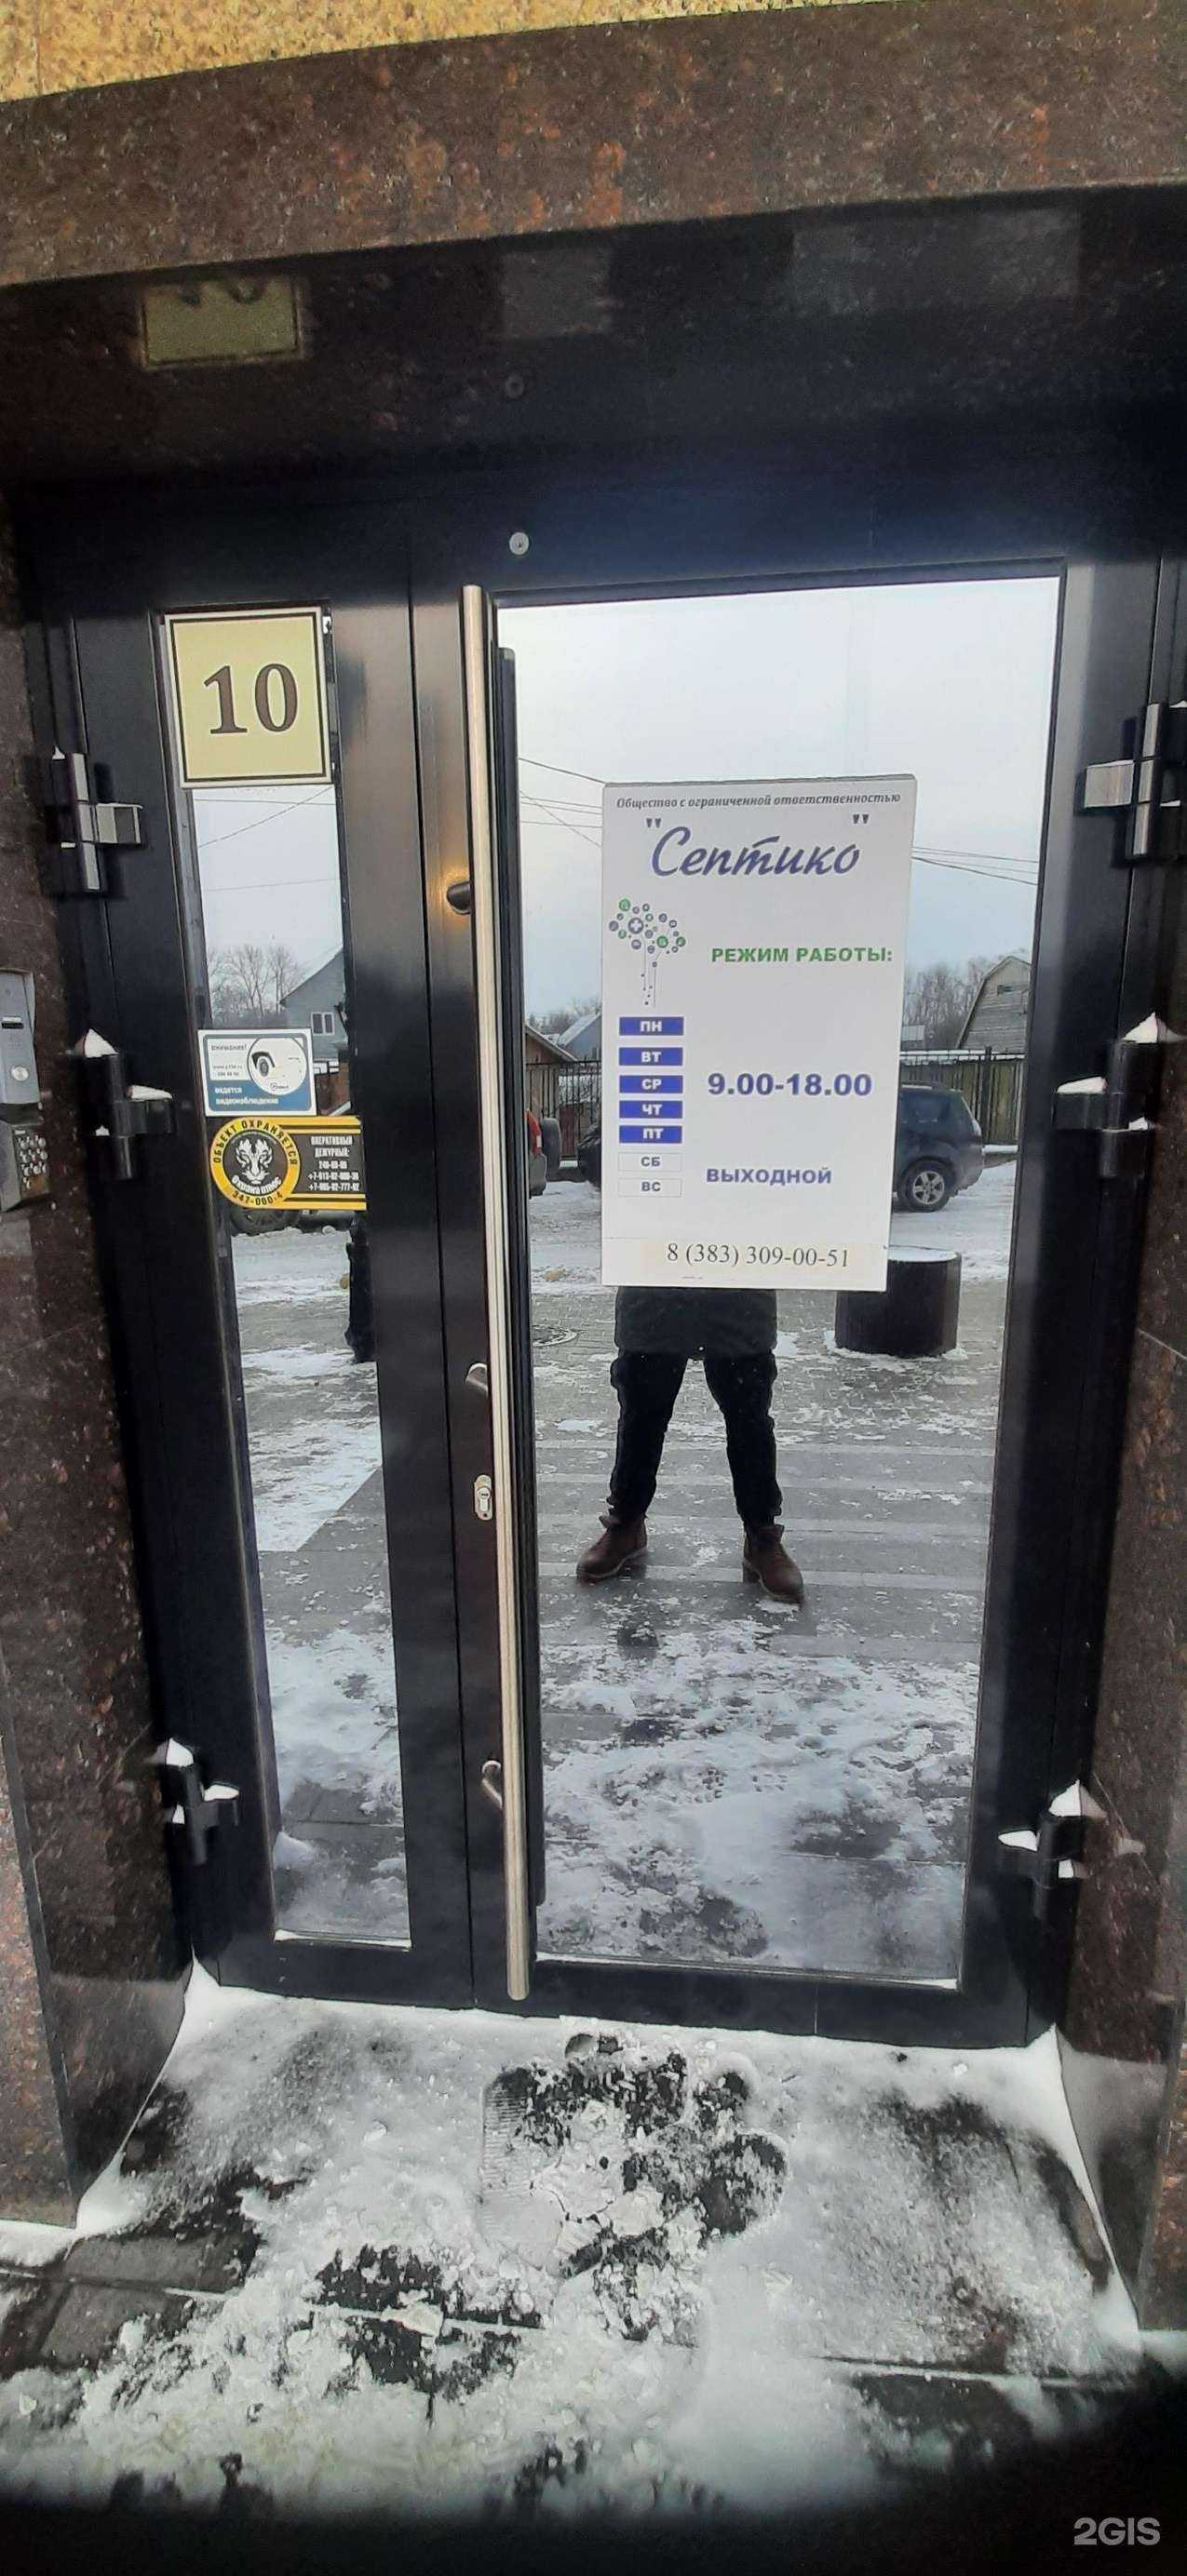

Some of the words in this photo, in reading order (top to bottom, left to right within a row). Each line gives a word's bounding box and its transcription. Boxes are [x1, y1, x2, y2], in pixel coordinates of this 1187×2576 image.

[204, 663, 298, 734] 10
[616, 798, 677, 809] Общество
[688, 795, 771, 809] ограниченной
[774, 794, 901, 806] ответственностью
[711, 947, 789, 962] РЕЖИМ
[796, 947, 893, 962] РАБОТЫ:
[641, 1021, 662, 1033] ПН
[641, 1052, 661, 1063] ВТ
[641, 1079, 662, 1090] СР
[708, 1073, 872, 1095] 9.00-18.00
[641, 1104, 662, 1116] ЧТ
[642, 1128, 663, 1140] ПТ
[213, 1124, 237, 1163] ОБЪЕКТ
[241, 1119, 298, 1165] ОХРАНЯЕТСЯ
[641, 1156, 660, 1167] СБ
[706, 1167, 831, 1186] ВЫХОДНОЙ
[641, 1182, 661, 1192] ВС
[668, 1243, 679, 1261] 8
[686, 1244, 739, 1267] (383)
[747, 1246, 848, 1268] 309-00-51
